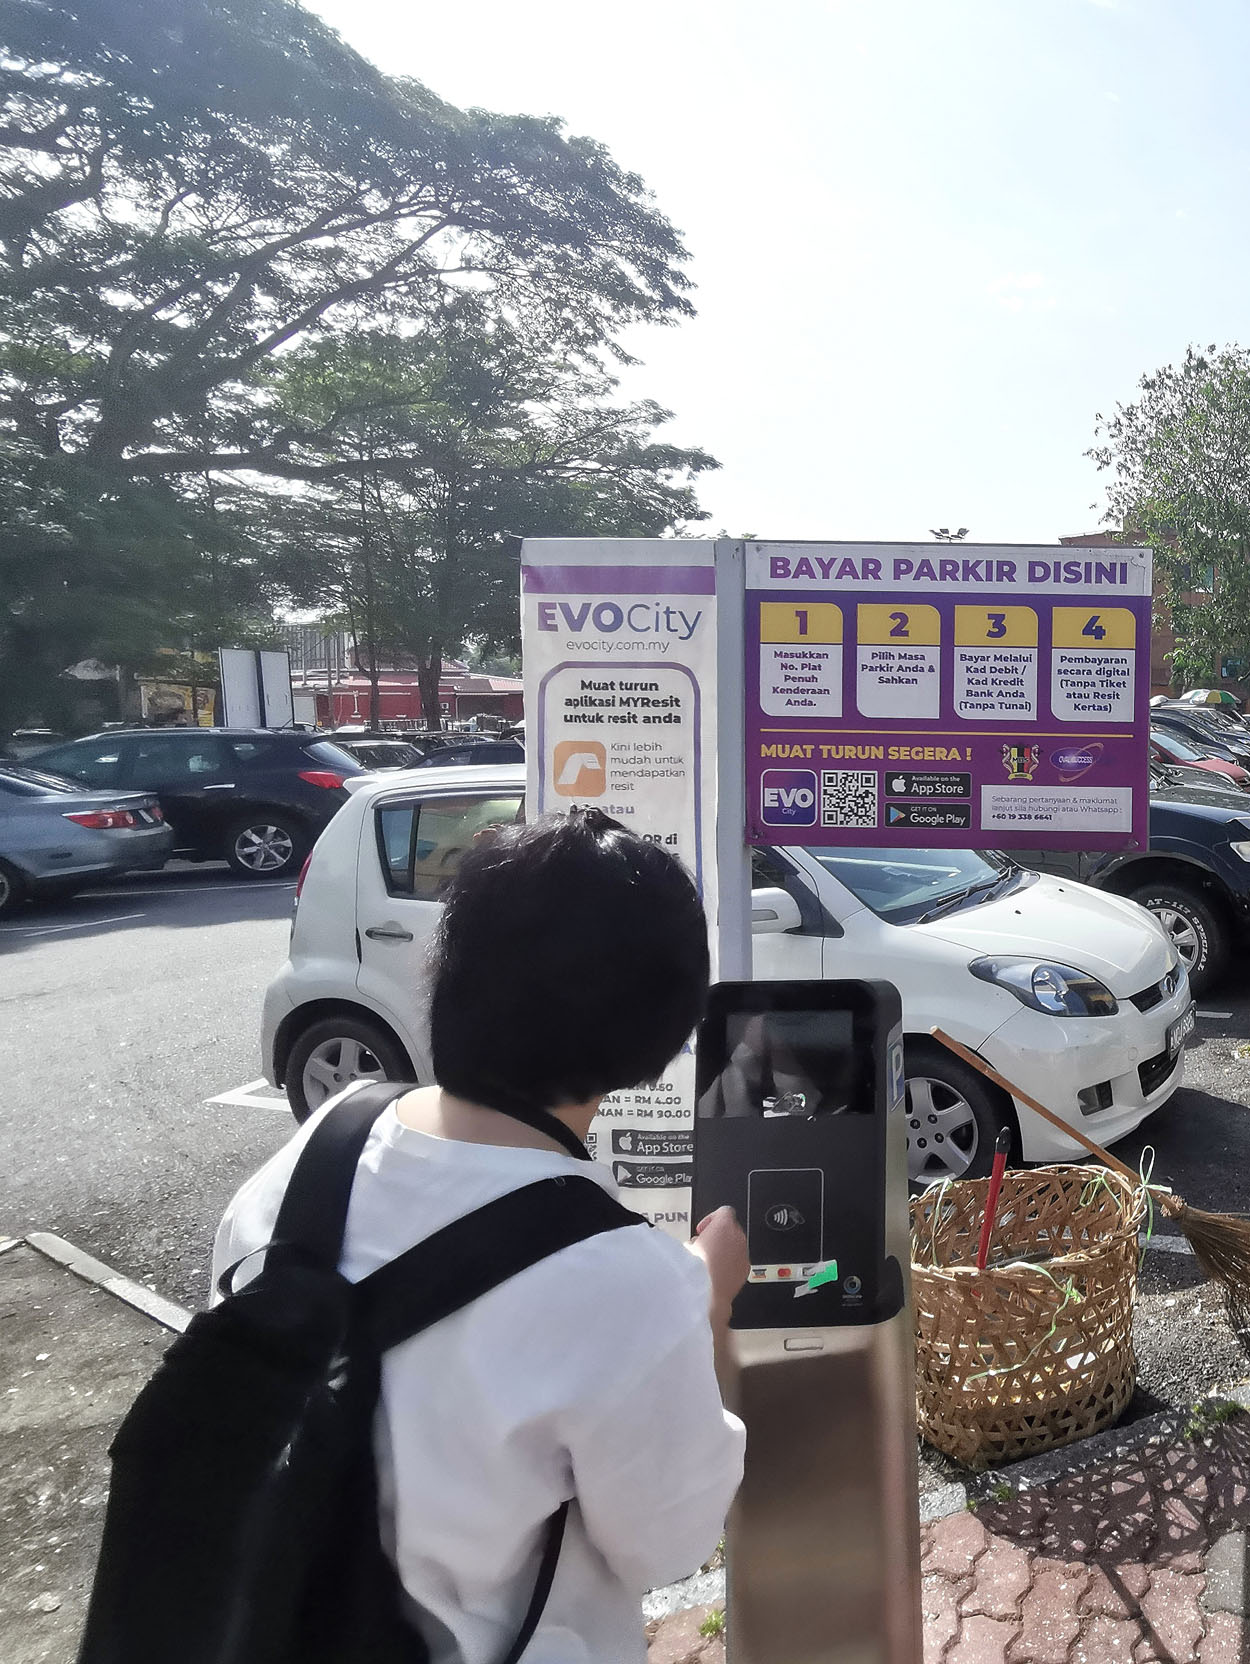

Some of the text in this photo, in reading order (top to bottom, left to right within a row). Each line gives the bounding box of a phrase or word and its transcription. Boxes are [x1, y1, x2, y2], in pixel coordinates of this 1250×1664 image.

[769, 556, 1128, 585] BAYAR PARKIR DISINI
[537, 601, 703, 640] EVOCity
[795, 610, 809, 636] 1
[889, 611, 910, 638] 2
[986, 613, 1007, 639] 3
[1081, 615, 1106, 640] 4
[566, 640, 670, 653] evocity.com.my
[773, 650, 829, 660] Masukkan
[871, 651, 926, 662] Pilih Masa
[959, 653, 1033, 664] Bayar Melalui
[1060, 655, 1128, 667] Pembayaran
[780, 662, 822, 672] No. Plat
[861, 663, 936, 674] Parkir Anda &
[965, 665, 1028, 676] Kad Debit /
[1057, 666, 1130, 679] secara digital
[784, 674, 819, 684] Penuh
[878, 675, 919, 686] Sahkan
[967, 677, 1025, 688] Kad Kredit
[1059, 679, 1127, 690] (Tanpa Tiket
[580, 680, 659, 692] Muat turun
[772, 686, 830, 696] Kenderaan
[966, 689, 1026, 700] Bank Anda
[1065, 691, 1121, 701] atau Resit
[564, 695, 682, 709] aplikasi MYResit
[785, 698, 817, 708] Anda.
[959, 701, 1032, 713] (Tanpa Tunai)
[1073, 703, 1113, 714] Kertas)
[563, 711, 682, 725] untuk resit anda
[610, 742, 663, 752] Kini lebih
[760, 744, 972, 761] MUAT TURUN SEGERA !
[610, 756, 685, 765] mudah untuk
[610, 768, 685, 778] mendapatkan
[610, 782, 635, 791] resit
[911, 783, 964, 796] App Store
[764, 788, 814, 808] EVO
[992, 795, 1028, 804] Sebarang
[602, 804, 635, 815] atau
[782, 808, 797, 816] City
[910, 814, 966, 826] Google Play
[665, 834, 678, 845] di
[1191, 916, 1208, 971] SPECIAL
[603, 1095, 621, 1104] AN
[634, 1095, 651, 1104] RM
[654, 1096, 682, 1105] 4.00
[597, 1108, 623, 1117] NAN
[636, 1108, 653, 1118] RM
[656, 1109, 691, 1119] 90.00
[637, 1141, 694, 1155] App Store
[636, 1173, 674, 1186] Google
